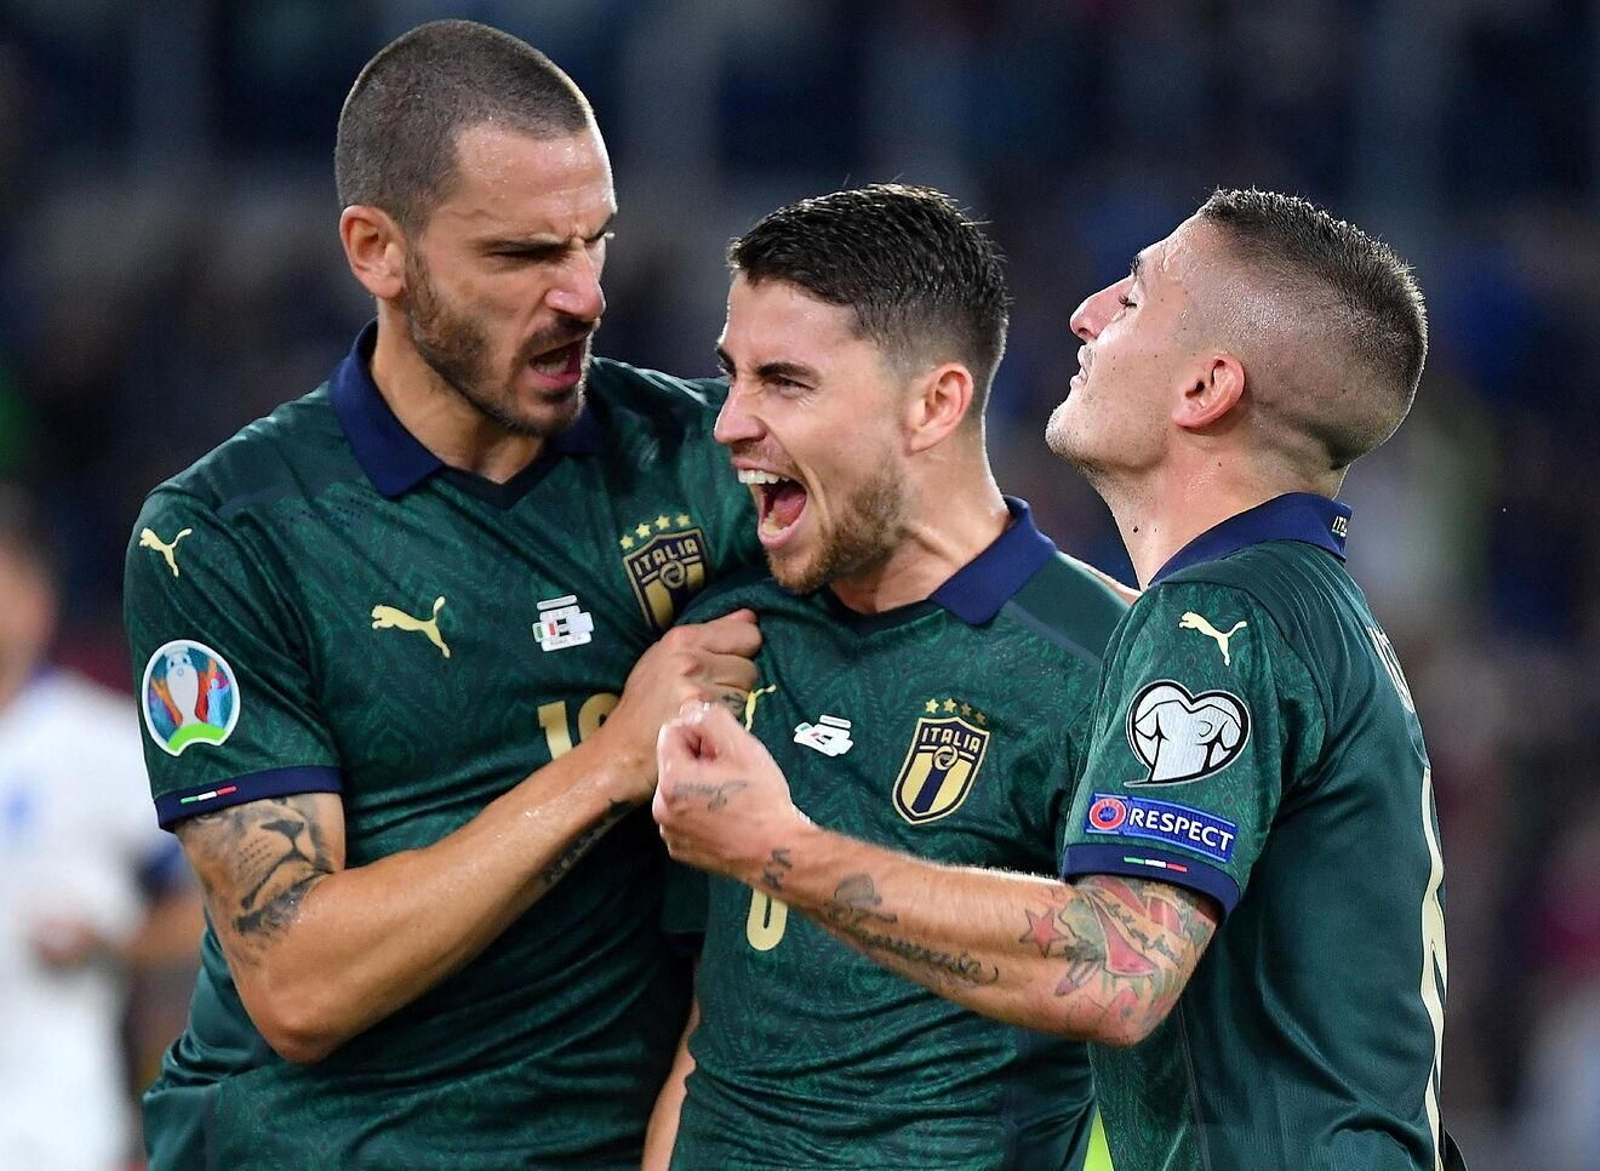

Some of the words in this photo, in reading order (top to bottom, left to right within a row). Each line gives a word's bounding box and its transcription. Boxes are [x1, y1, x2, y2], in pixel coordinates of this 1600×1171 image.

[633, 538, 699, 576] ITALIA
[921, 726, 982, 754] ITALIA
[1129, 807, 1235, 851] RESPECT
